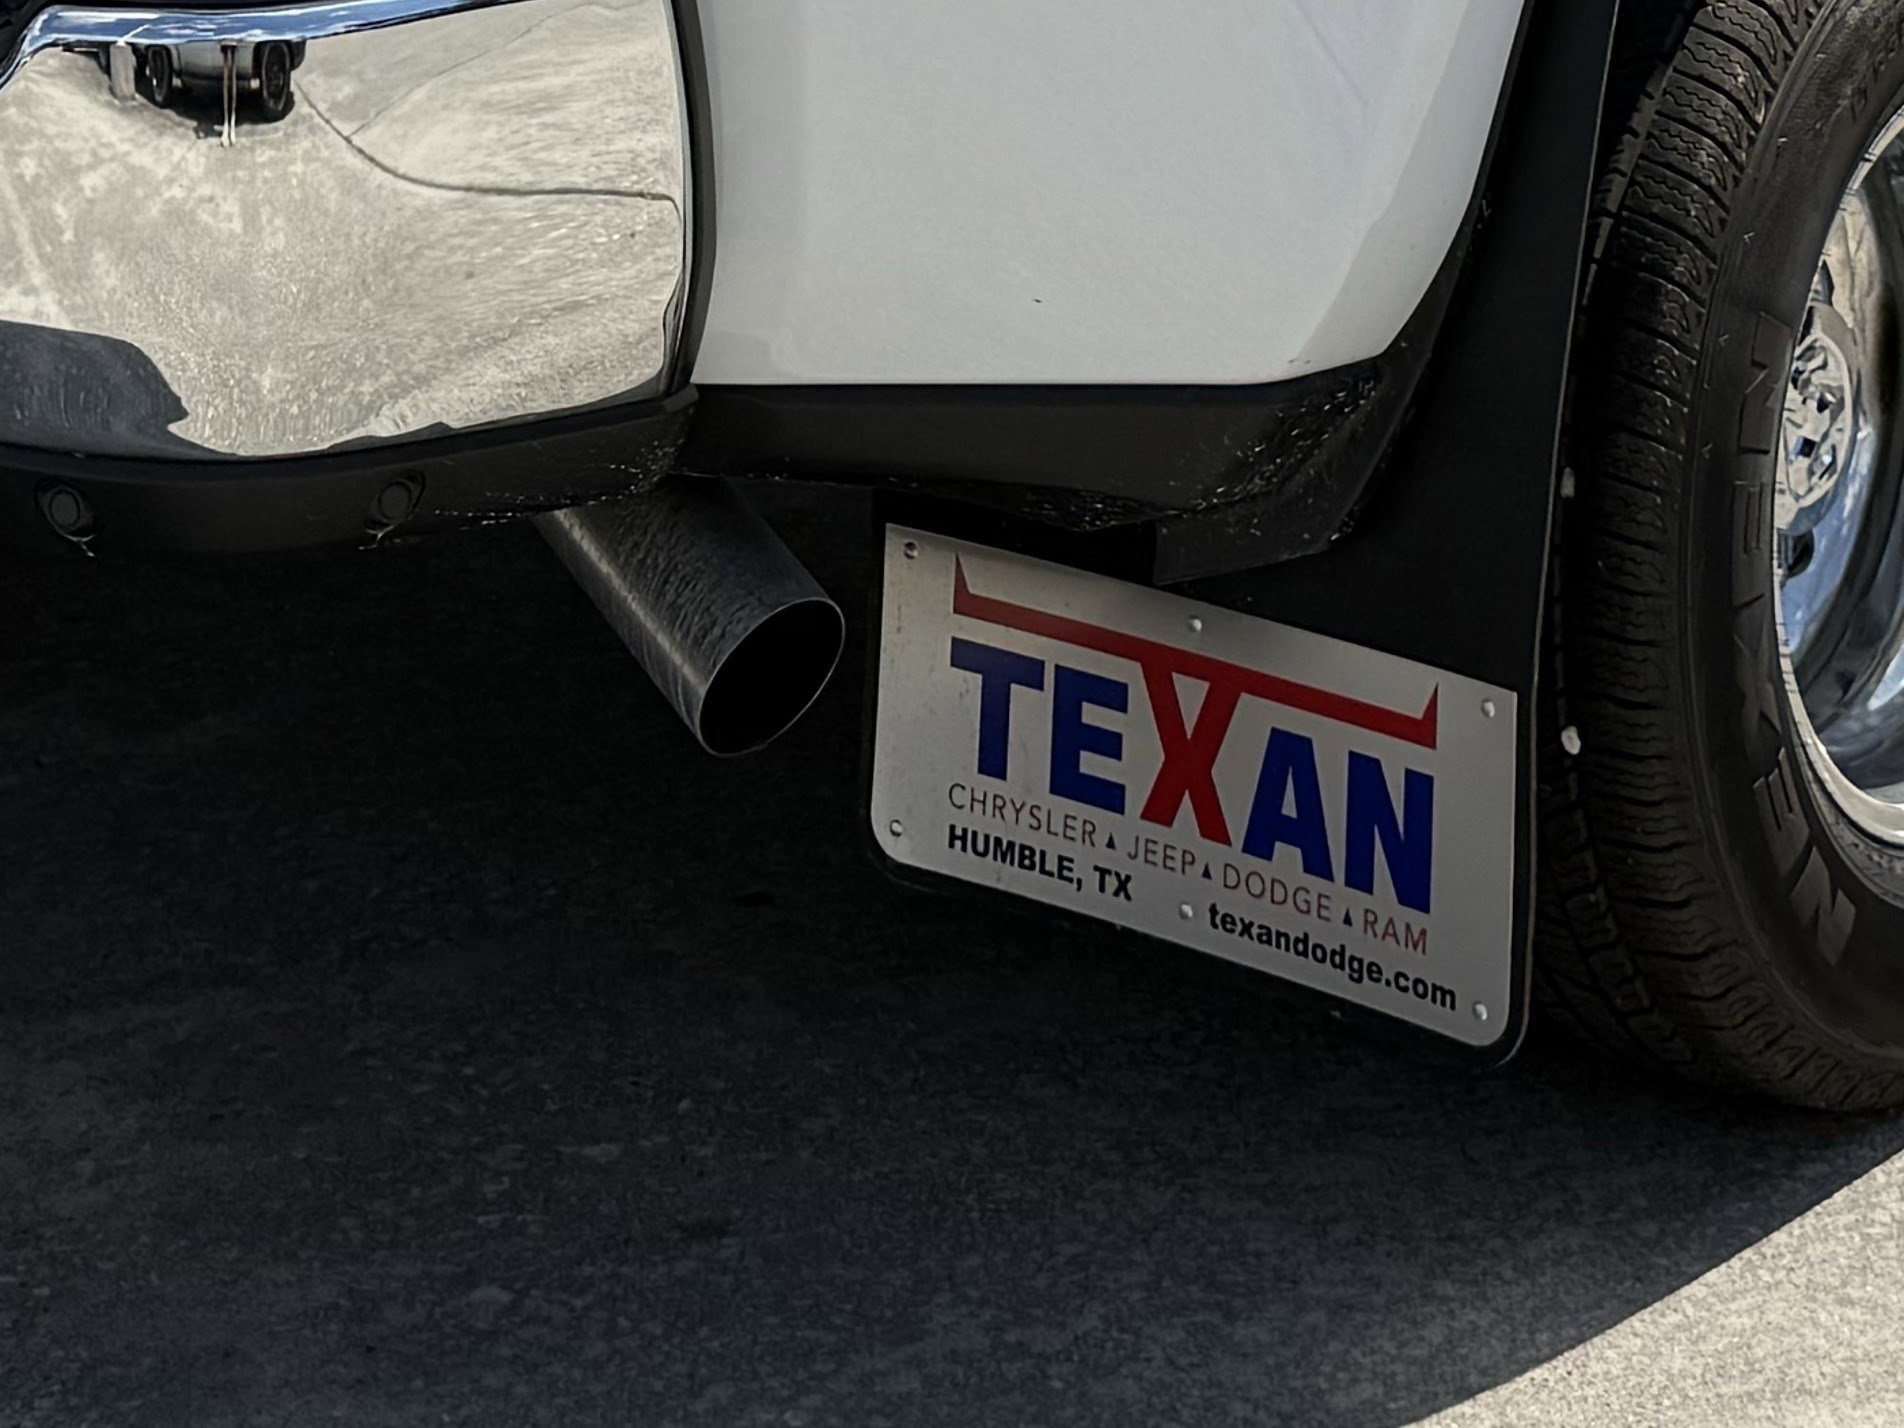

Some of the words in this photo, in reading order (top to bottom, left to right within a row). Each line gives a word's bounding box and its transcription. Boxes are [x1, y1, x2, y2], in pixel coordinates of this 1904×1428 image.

[950, 624, 1436, 915] TEXAN
[948, 823, 1083, 892] HUMBLE,
[1092, 865, 1133, 902] TX
[948, 781, 1097, 848] CHRYSLER
[1126, 834, 1196, 876] JEEP
[1222, 863, 1332, 923] DODGE
[1361, 908, 1429, 956] RAM
[1208, 901, 1457, 1011] texandodge.com
